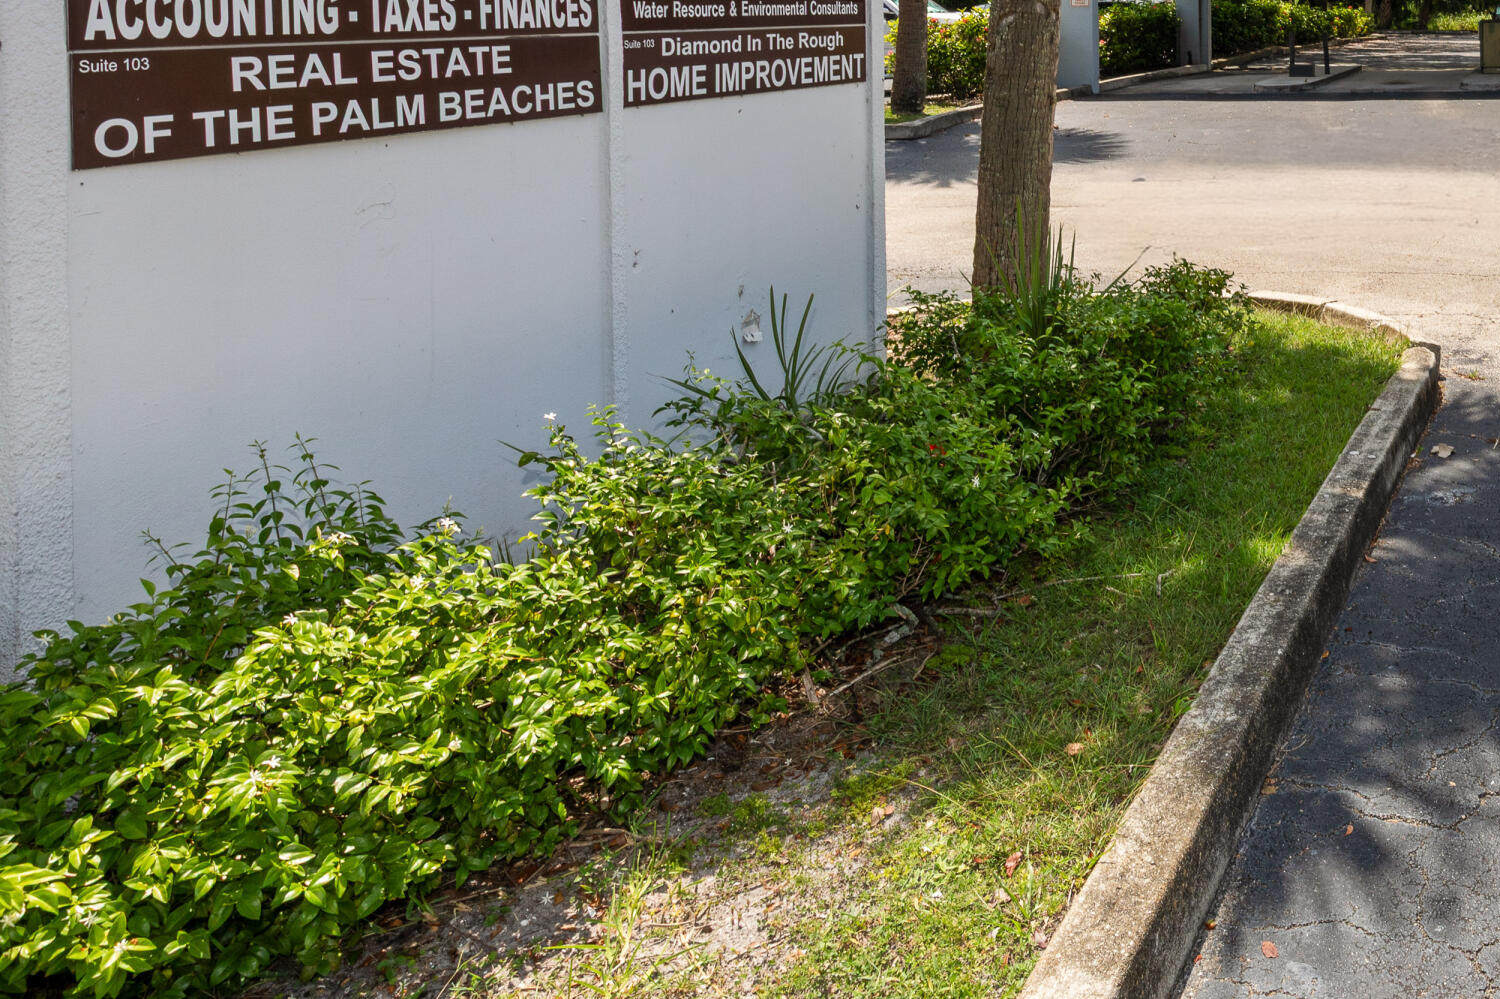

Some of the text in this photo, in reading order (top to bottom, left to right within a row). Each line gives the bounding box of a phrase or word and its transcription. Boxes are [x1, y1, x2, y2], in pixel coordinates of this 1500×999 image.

[633, 0, 859, 19] Water Resource & Environmental Consultants
[624, 39, 655, 50] Suite 103
[661, 31, 844, 57] Diamond In The Rough
[78, 57, 150, 73] Suite 103
[231, 45, 513, 92] REAL ESTATE
[627, 53, 865, 103] HOME IMPROVEMENT
[94, 80, 596, 158] OF THE PALM BEACHES
